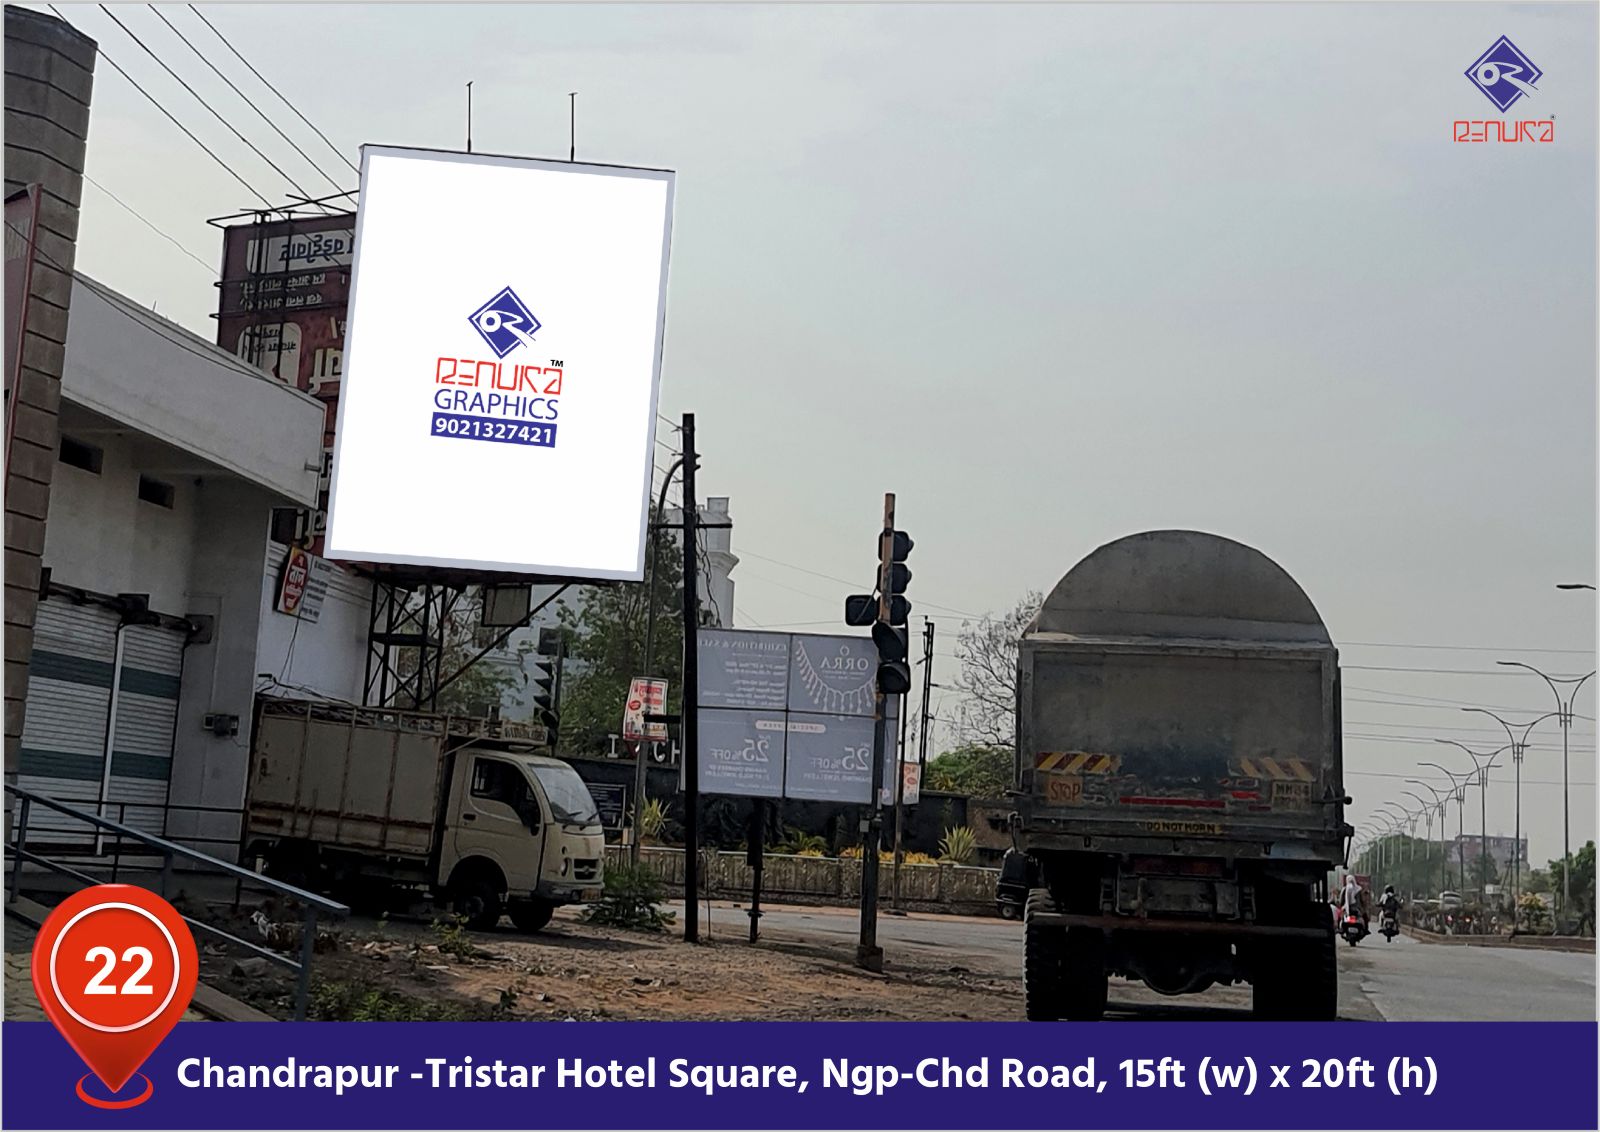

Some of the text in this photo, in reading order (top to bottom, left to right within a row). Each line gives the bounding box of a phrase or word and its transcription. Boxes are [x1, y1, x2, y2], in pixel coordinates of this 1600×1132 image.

[436, 357, 563, 395] RENUKA
[434, 388, 559, 420] GRAPHICS
[435, 417, 552, 444] 9021327421
[1050, 781, 1081, 802] STOP
[1162, 822, 1184, 832] NOT
